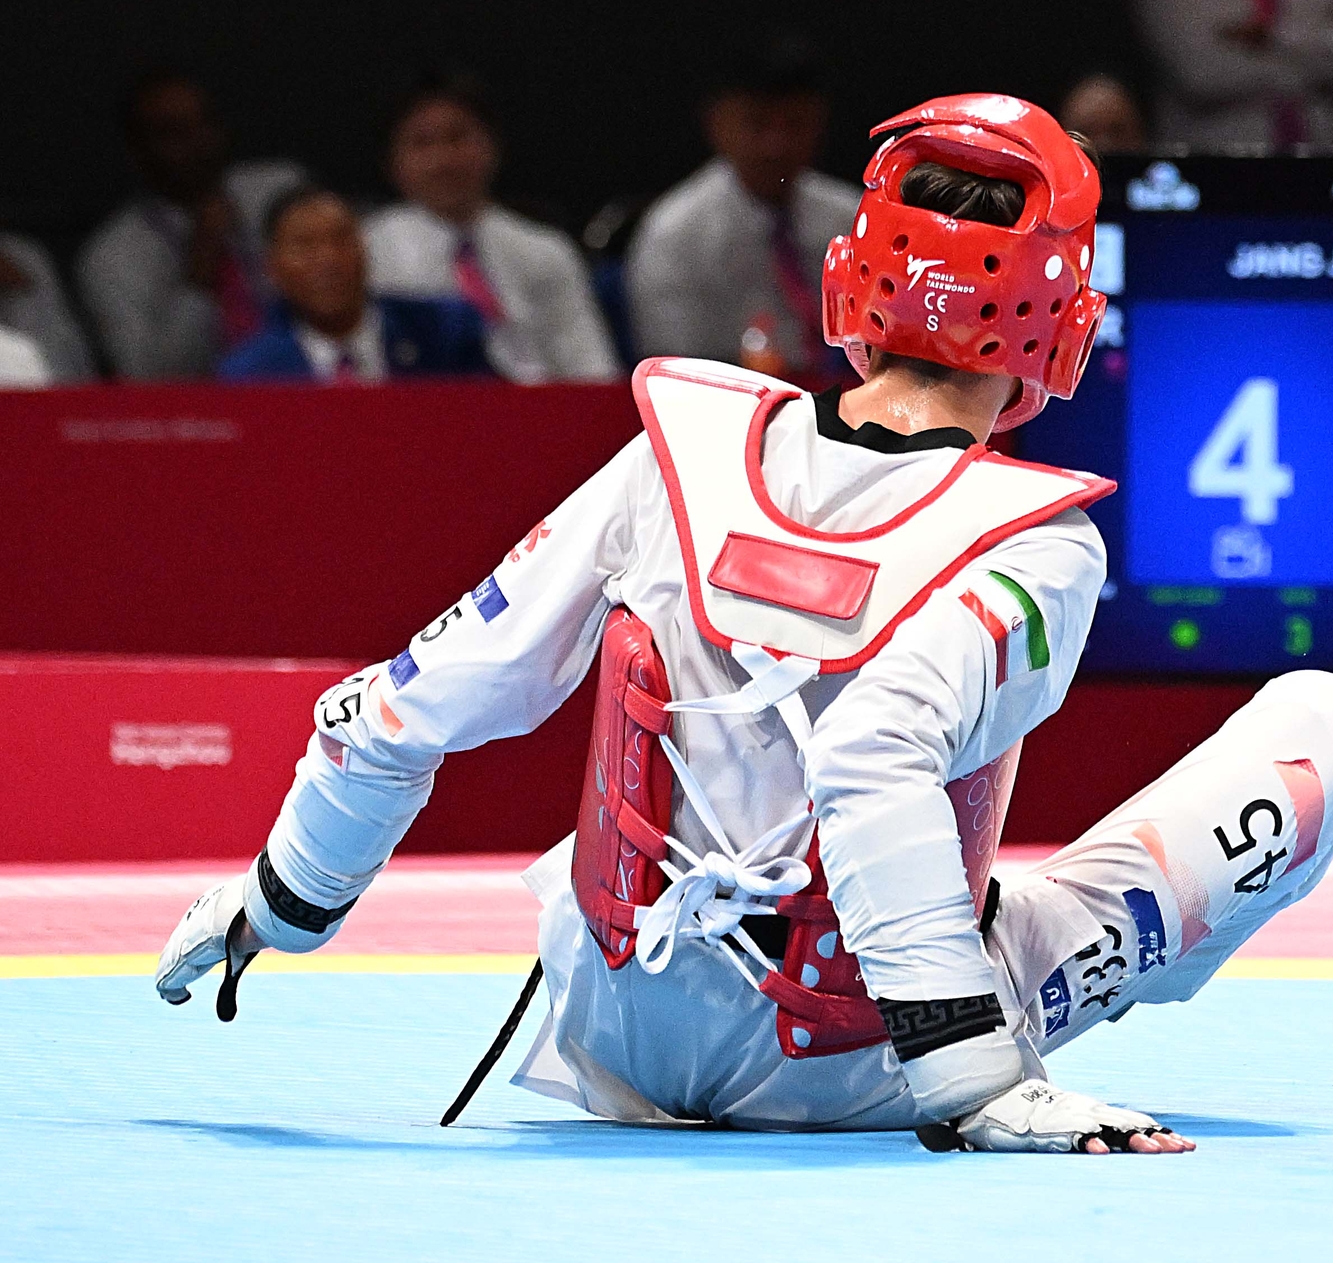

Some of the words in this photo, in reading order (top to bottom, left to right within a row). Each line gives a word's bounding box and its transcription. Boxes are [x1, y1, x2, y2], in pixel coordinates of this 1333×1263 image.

[927, 271, 955, 283] WORLD
[926, 280, 976, 294] TAEKWONDO
[926, 314, 939, 332] S
[1189, 375, 1294, 525] 4
[1213, 798, 1288, 895] 45
